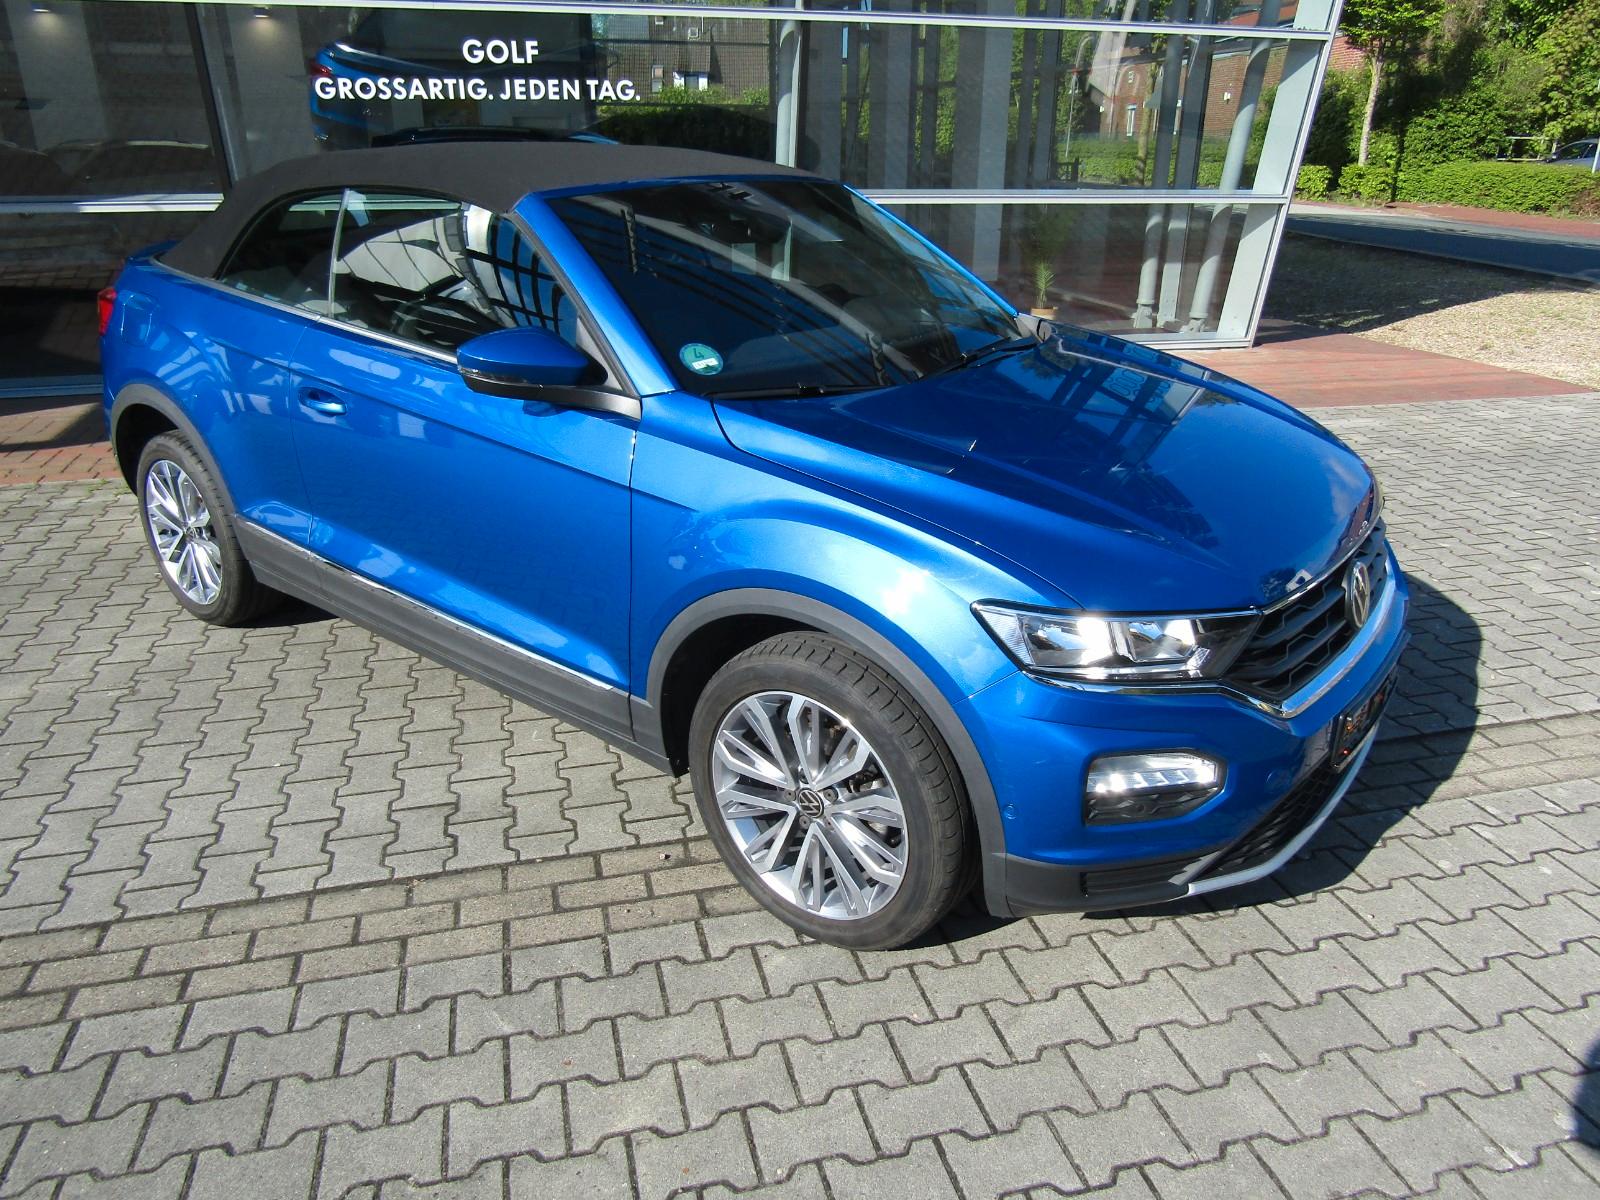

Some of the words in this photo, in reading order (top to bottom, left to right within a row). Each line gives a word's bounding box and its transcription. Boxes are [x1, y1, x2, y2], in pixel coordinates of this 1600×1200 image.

[462, 38, 539, 64] GOLF
[314, 77, 494, 100] GROSSARTIG.
[499, 78, 580, 100] JEDEN
[586, 79, 641, 101] TAG.
[693, 347, 704, 359] 4
